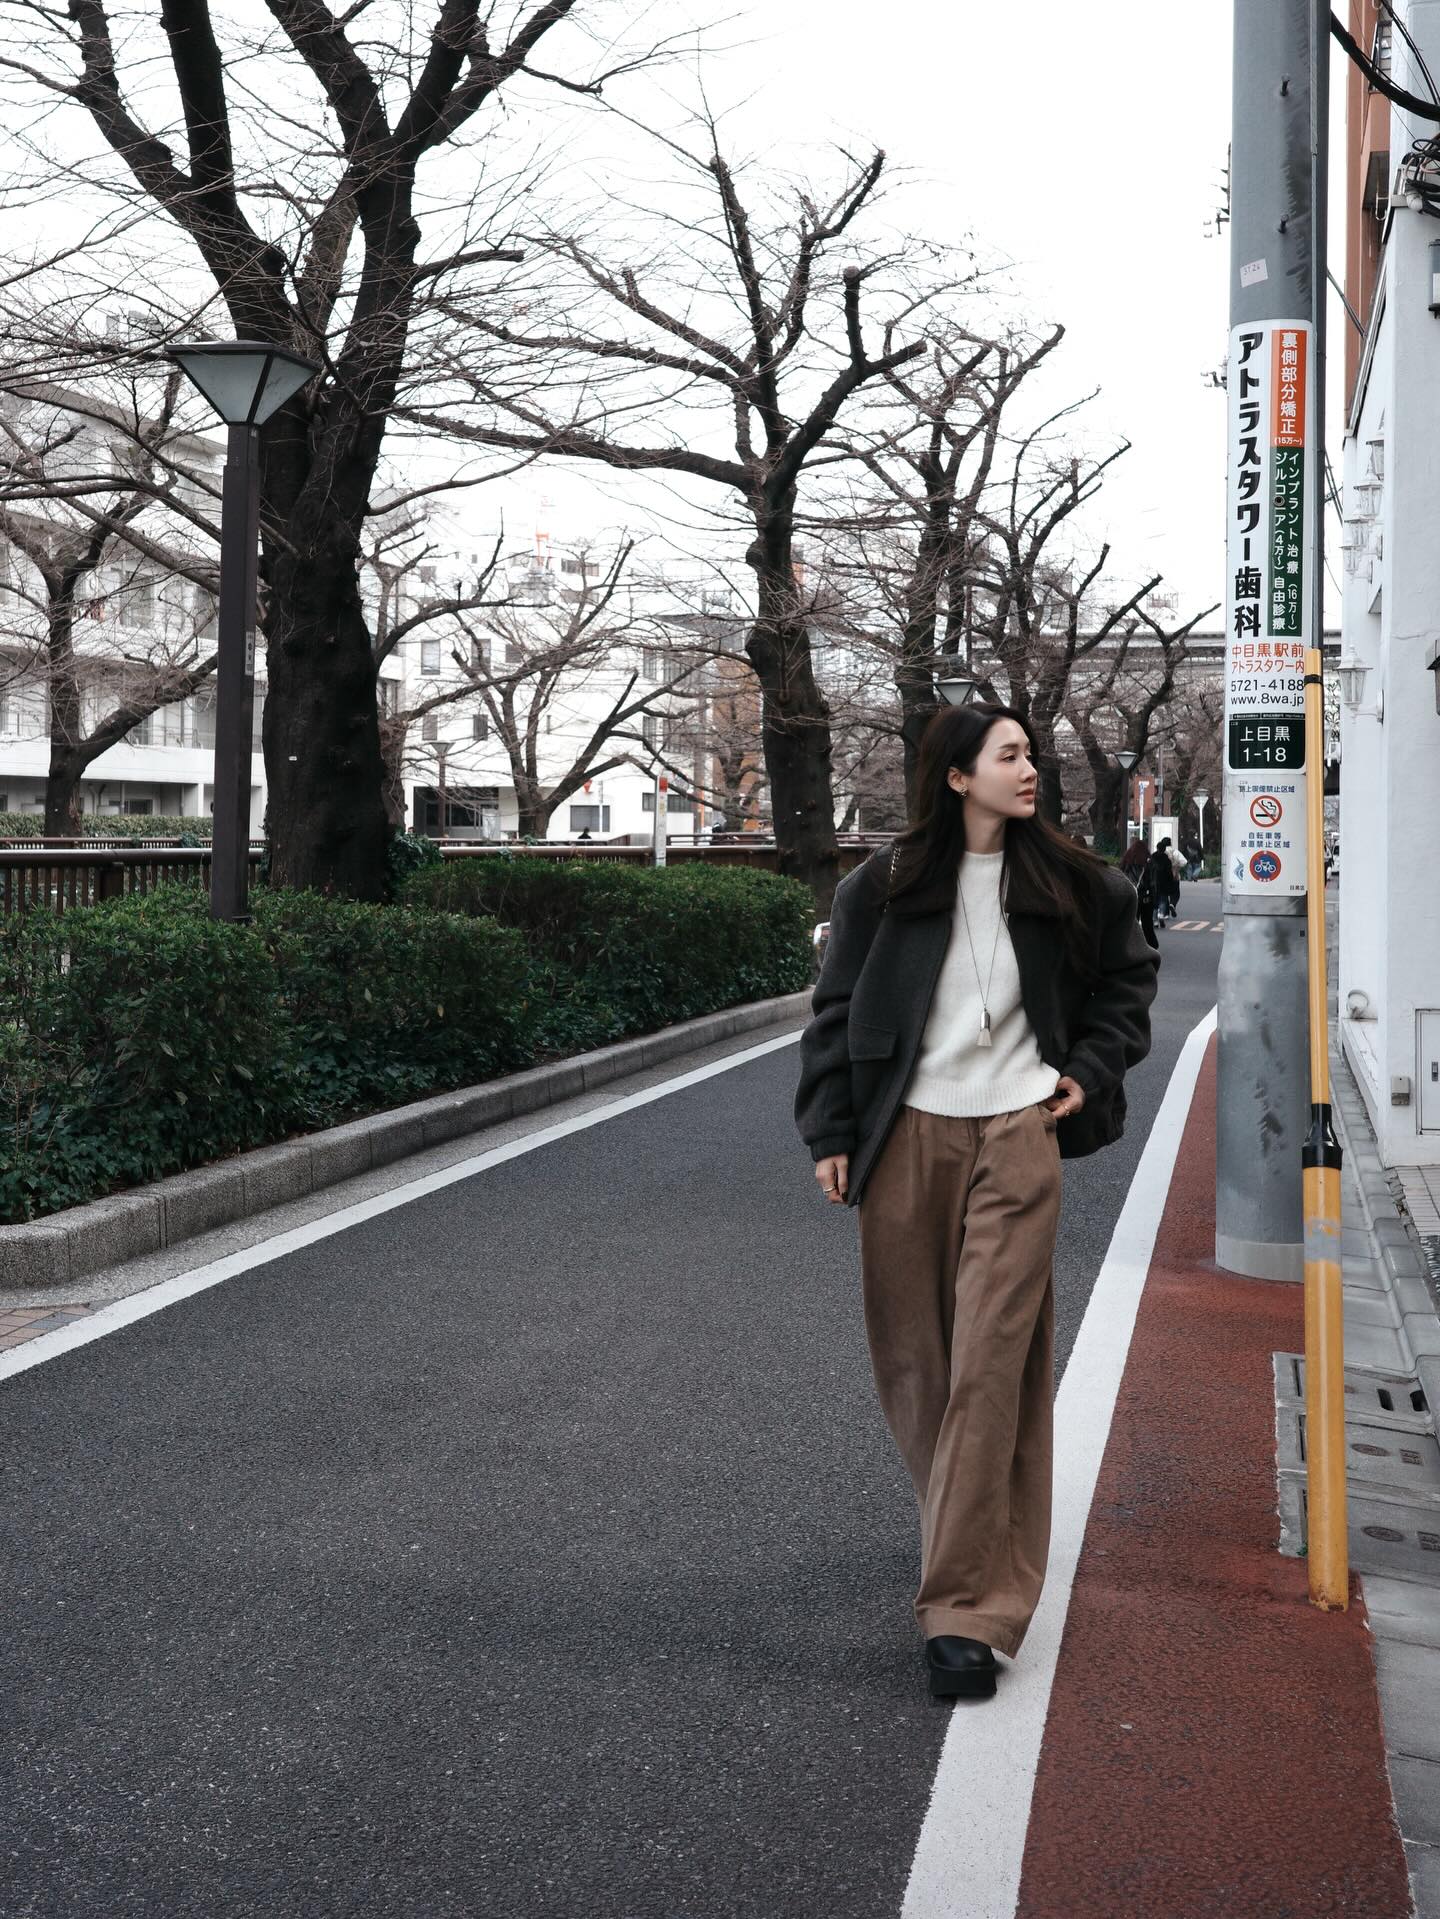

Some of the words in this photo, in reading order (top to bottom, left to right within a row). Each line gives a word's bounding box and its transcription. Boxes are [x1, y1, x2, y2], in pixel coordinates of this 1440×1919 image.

[1280, 332, 1298, 434] 裏側部分矯正
[1234, 332, 1263, 638] アトラスタワー歯科
[1232, 643, 1304, 659] 中目黒駅前
[1231, 660, 1305, 674] アトラスタワー内
[1230, 679, 1304, 692] 5721-4188
[1230, 693, 1304, 706] www.8wa.jp
[1240, 726, 1290, 742] 上目黒
[1243, 747, 1287, 762] 1-18
